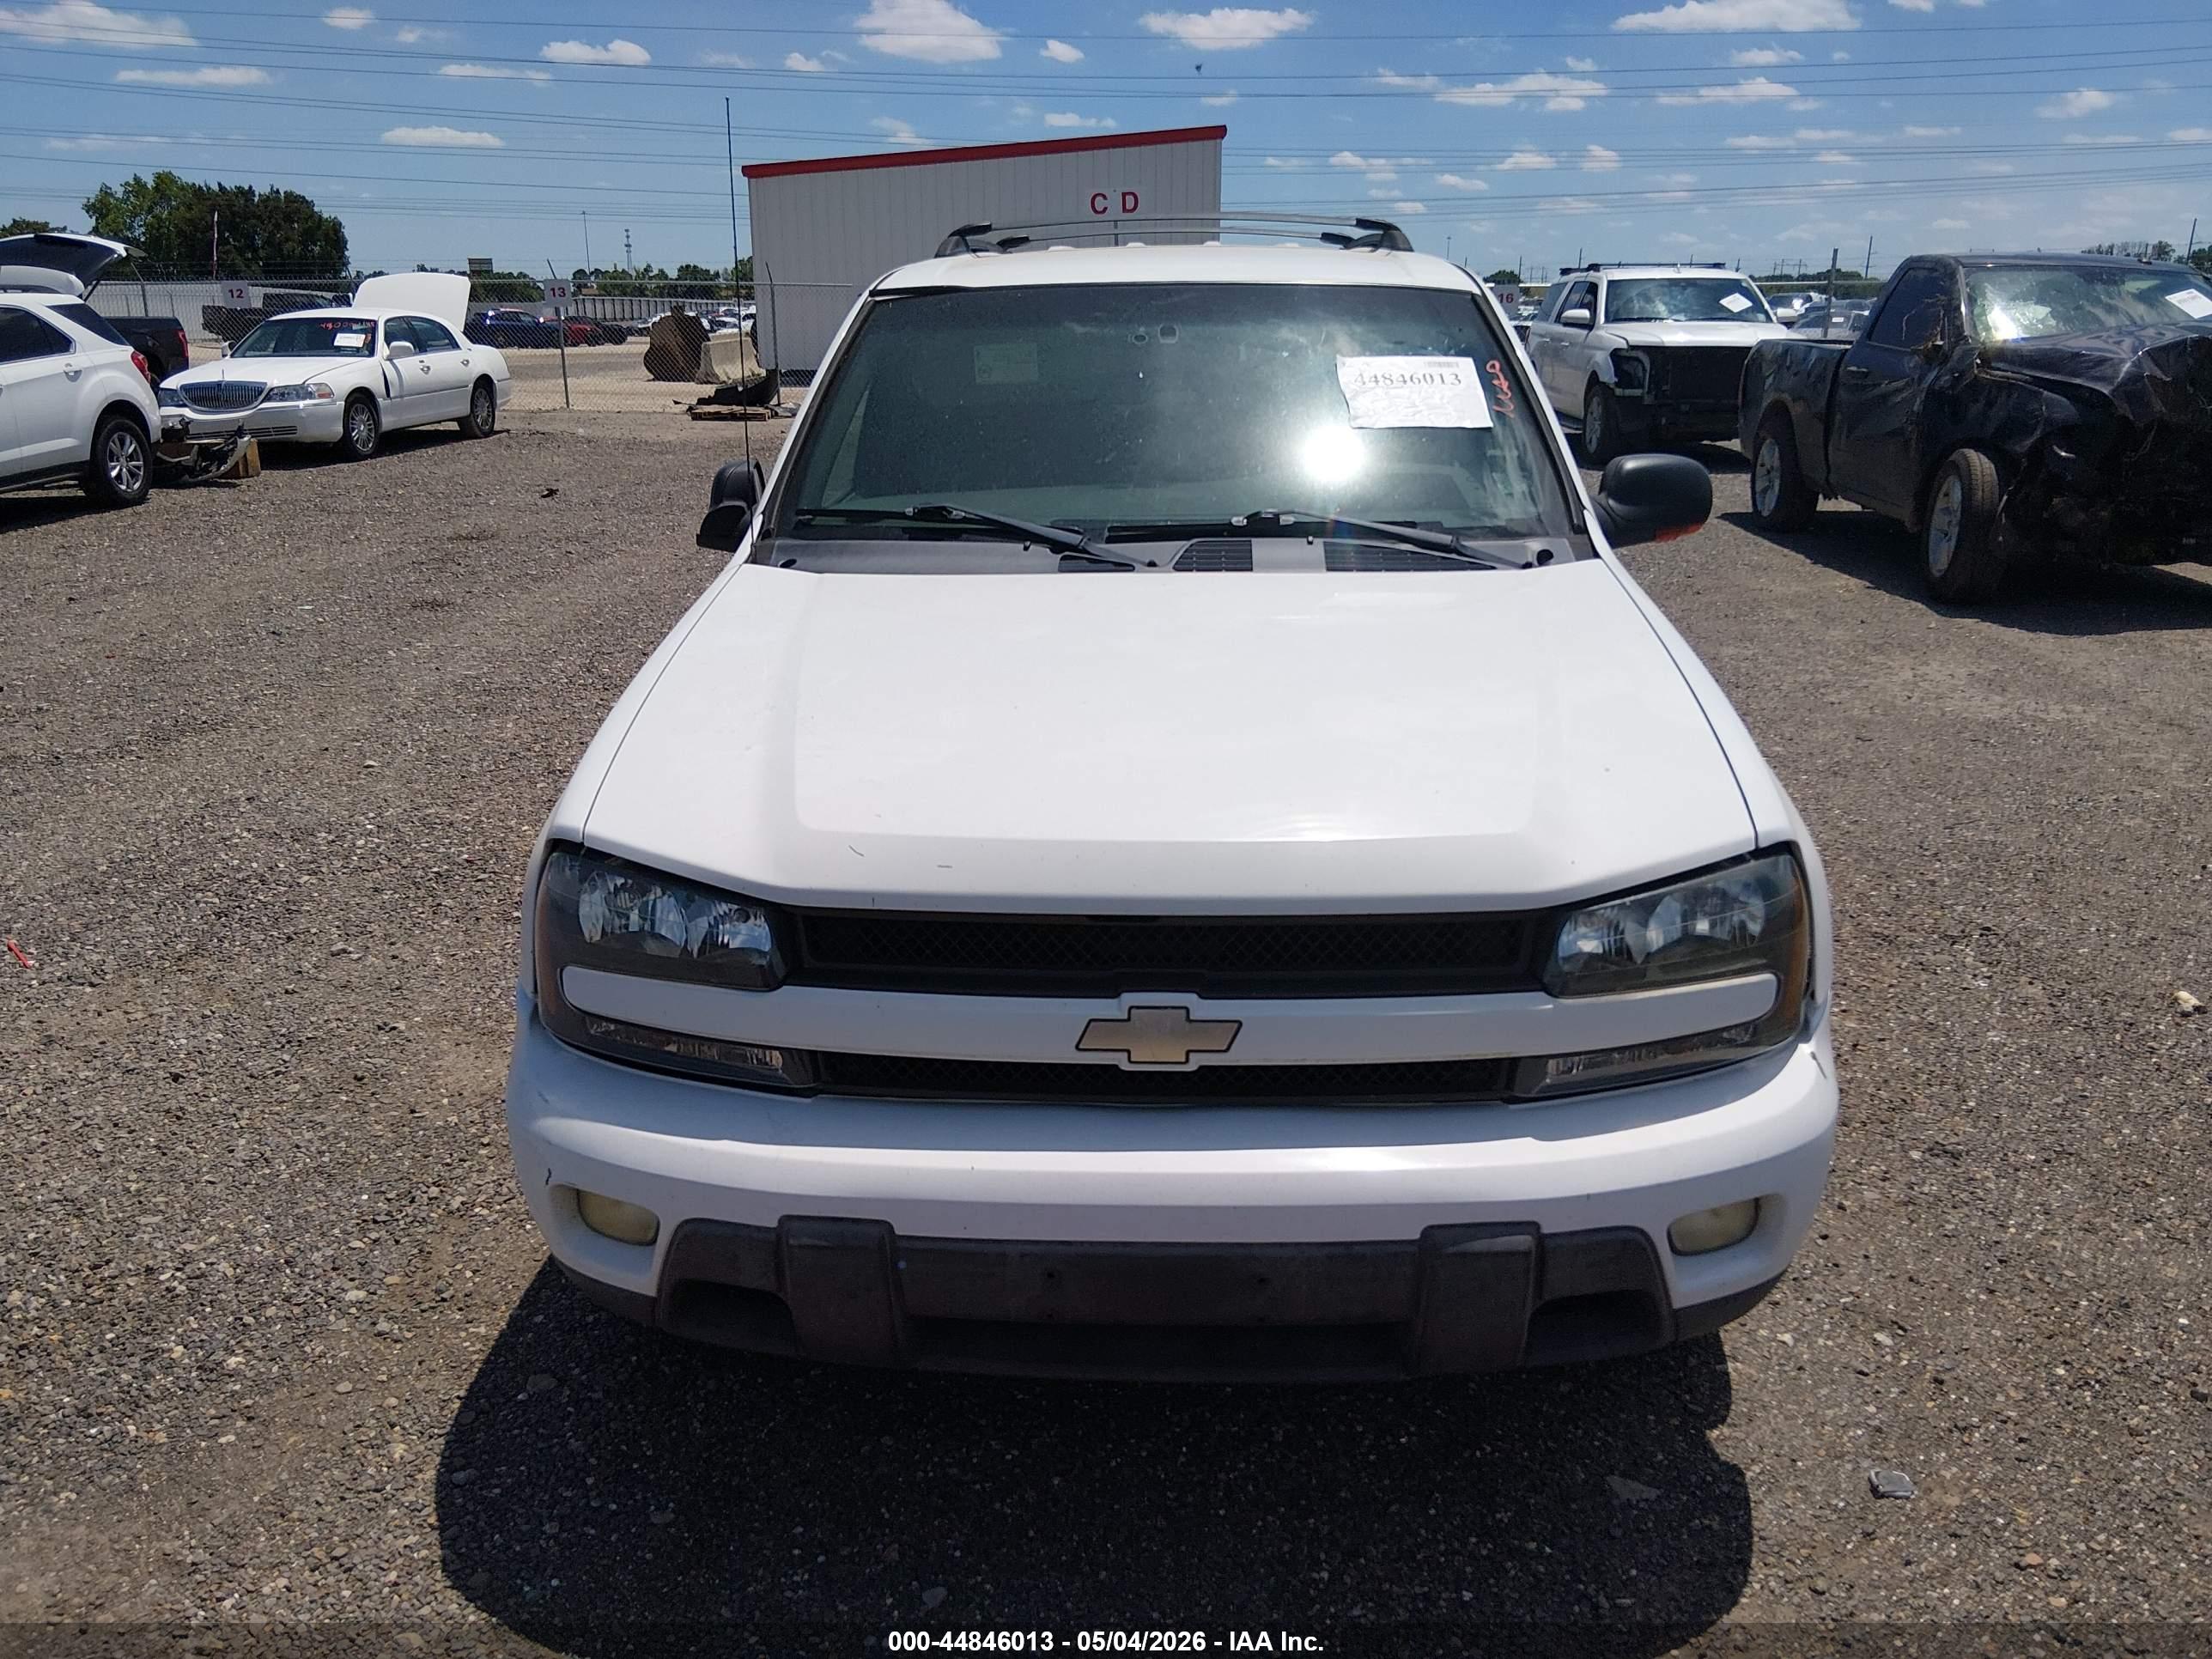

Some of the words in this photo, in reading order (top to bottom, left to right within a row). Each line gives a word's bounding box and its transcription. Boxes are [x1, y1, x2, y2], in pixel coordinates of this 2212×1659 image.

[1091, 192, 1108, 215] C
[1121, 191, 1139, 213] D
[228, 289, 244, 299] 12
[550, 287, 566, 298] 13
[1498, 293, 1514, 303] 16
[1354, 372, 1462, 386] 44846013
